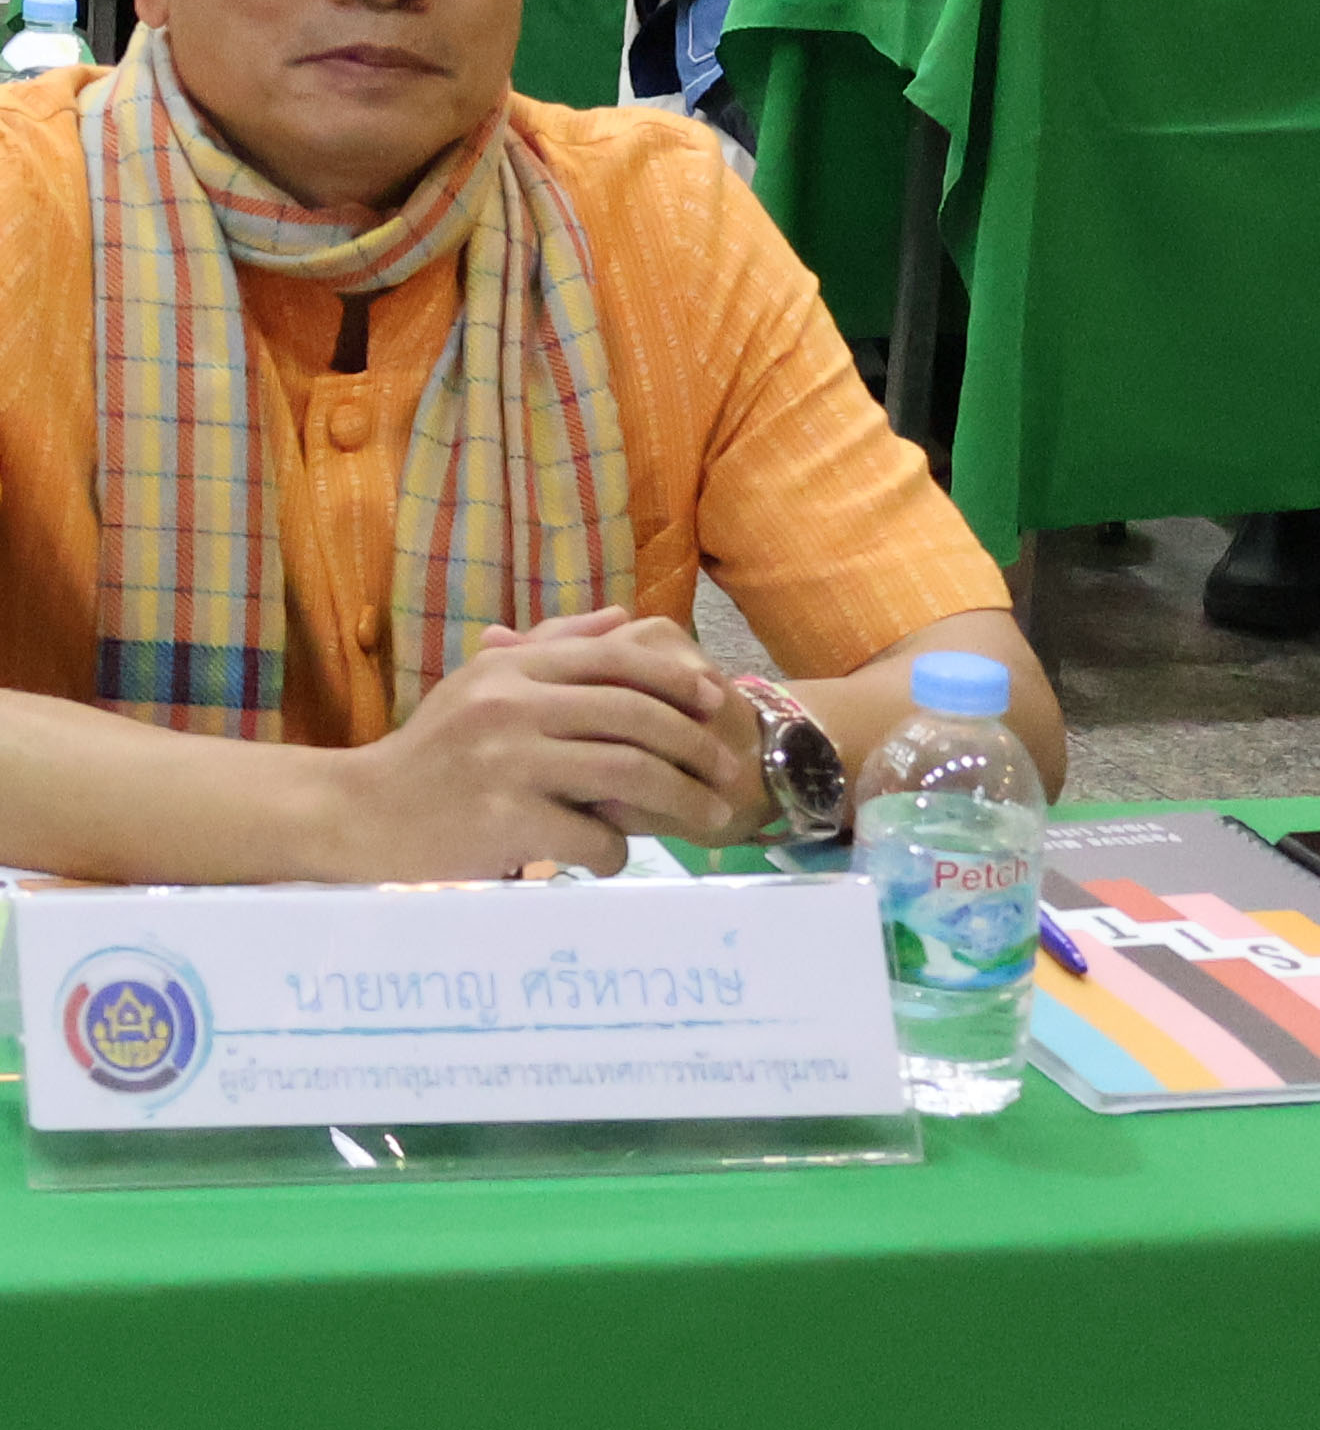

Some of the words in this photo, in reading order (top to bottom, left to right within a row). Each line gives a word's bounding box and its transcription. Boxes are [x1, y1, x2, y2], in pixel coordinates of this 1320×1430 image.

[933, 857, 1031, 892] Petch
[284, 969, 500, 1027] นายหาญ
[521, 928, 746, 1008] ศรีหาวงษ์
